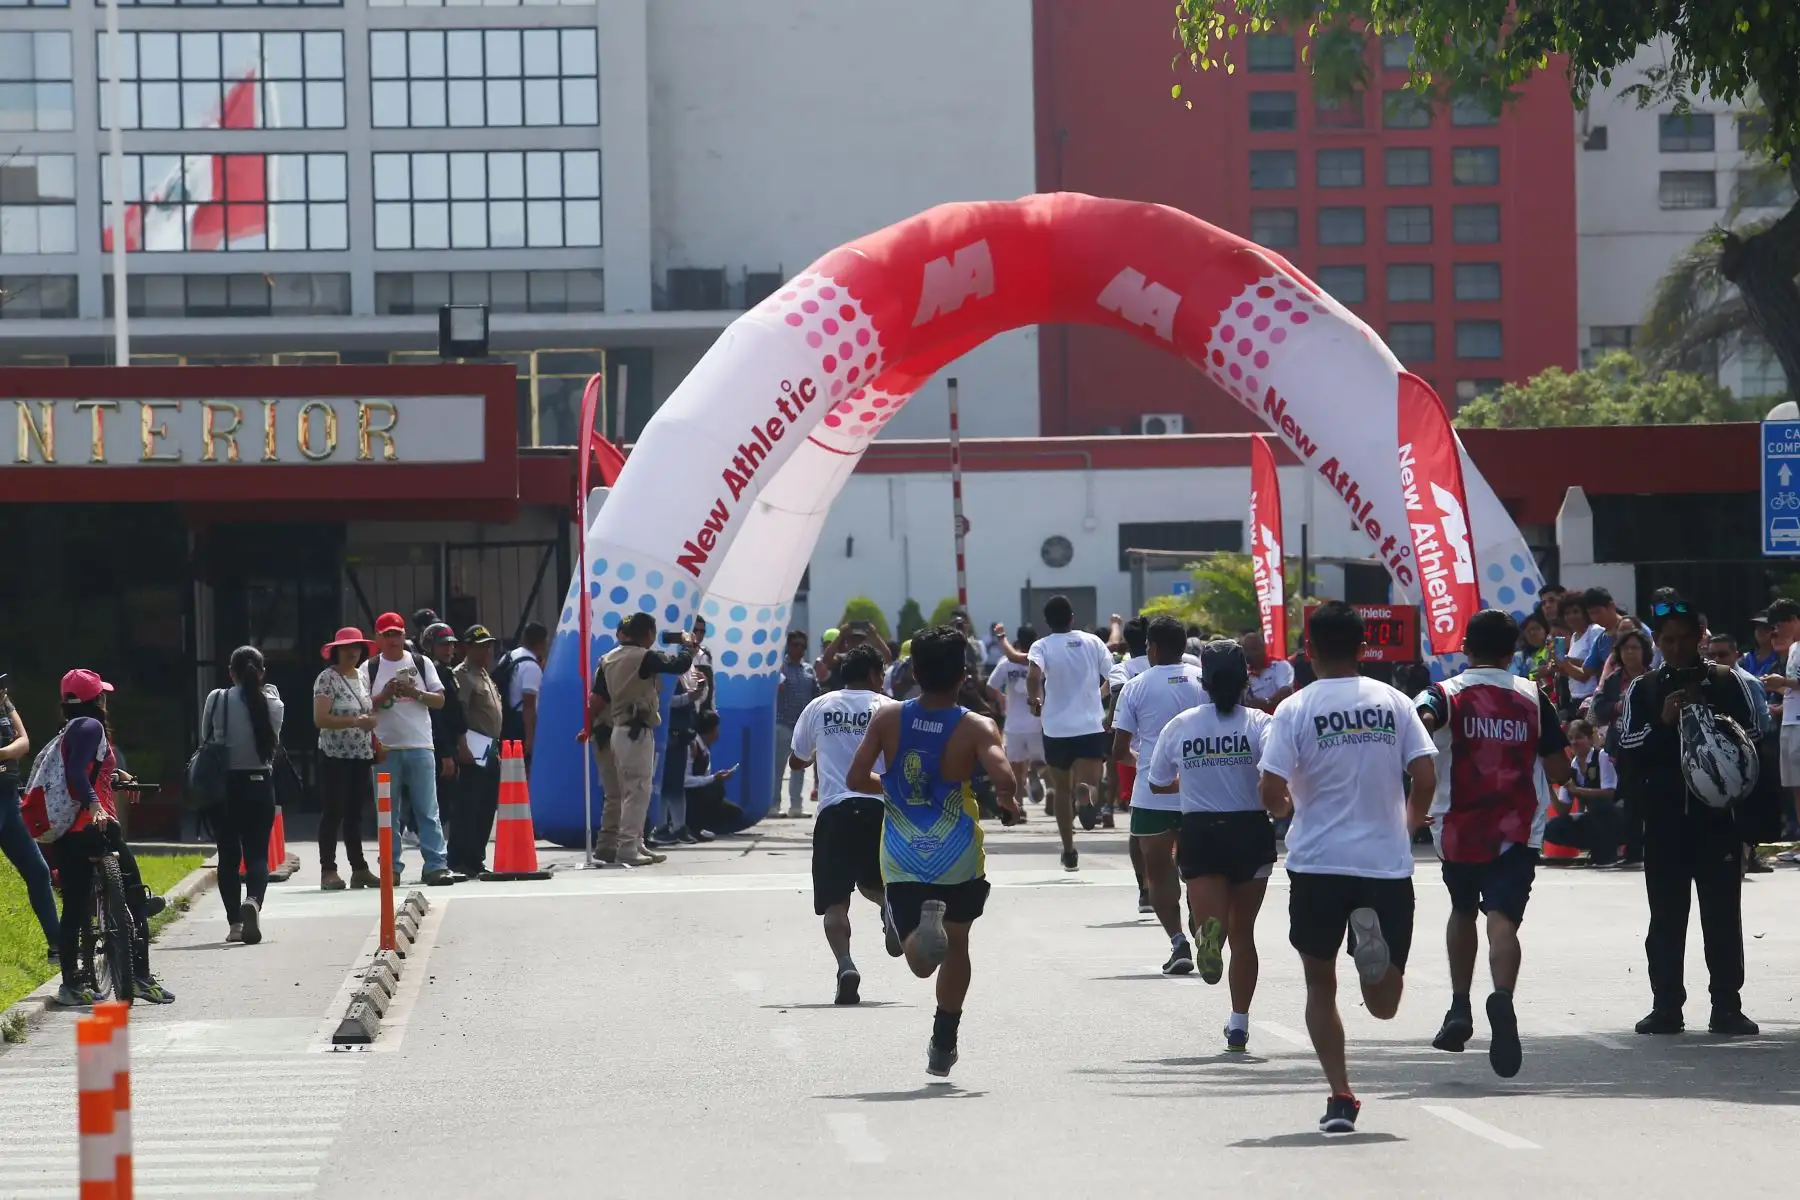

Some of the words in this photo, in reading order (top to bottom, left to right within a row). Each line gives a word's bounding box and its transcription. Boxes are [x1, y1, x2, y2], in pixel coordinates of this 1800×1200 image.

[13, 400, 400, 463] NTERIOR
[1768, 442, 1800, 453] COMP
[676, 498, 730, 577] New
[721, 377, 817, 502] Athletic
[1263, 385, 1317, 458] New
[1318, 456, 1413, 588] Athletic
[1398, 442, 1424, 511] New
[1410, 523, 1459, 634] Athletic
[1314, 704, 1396, 737] POLICÍA
[1463, 716, 1528, 742] UNMSM
[1182, 730, 1252, 758] POLICÍA
[1317, 735, 1341, 750] XXXI
[1341, 731, 1397, 747] ANIVERSARIO
[1183, 759, 1201, 770] XXXI
[1201, 756, 1253, 768] ANIVERSARIO
